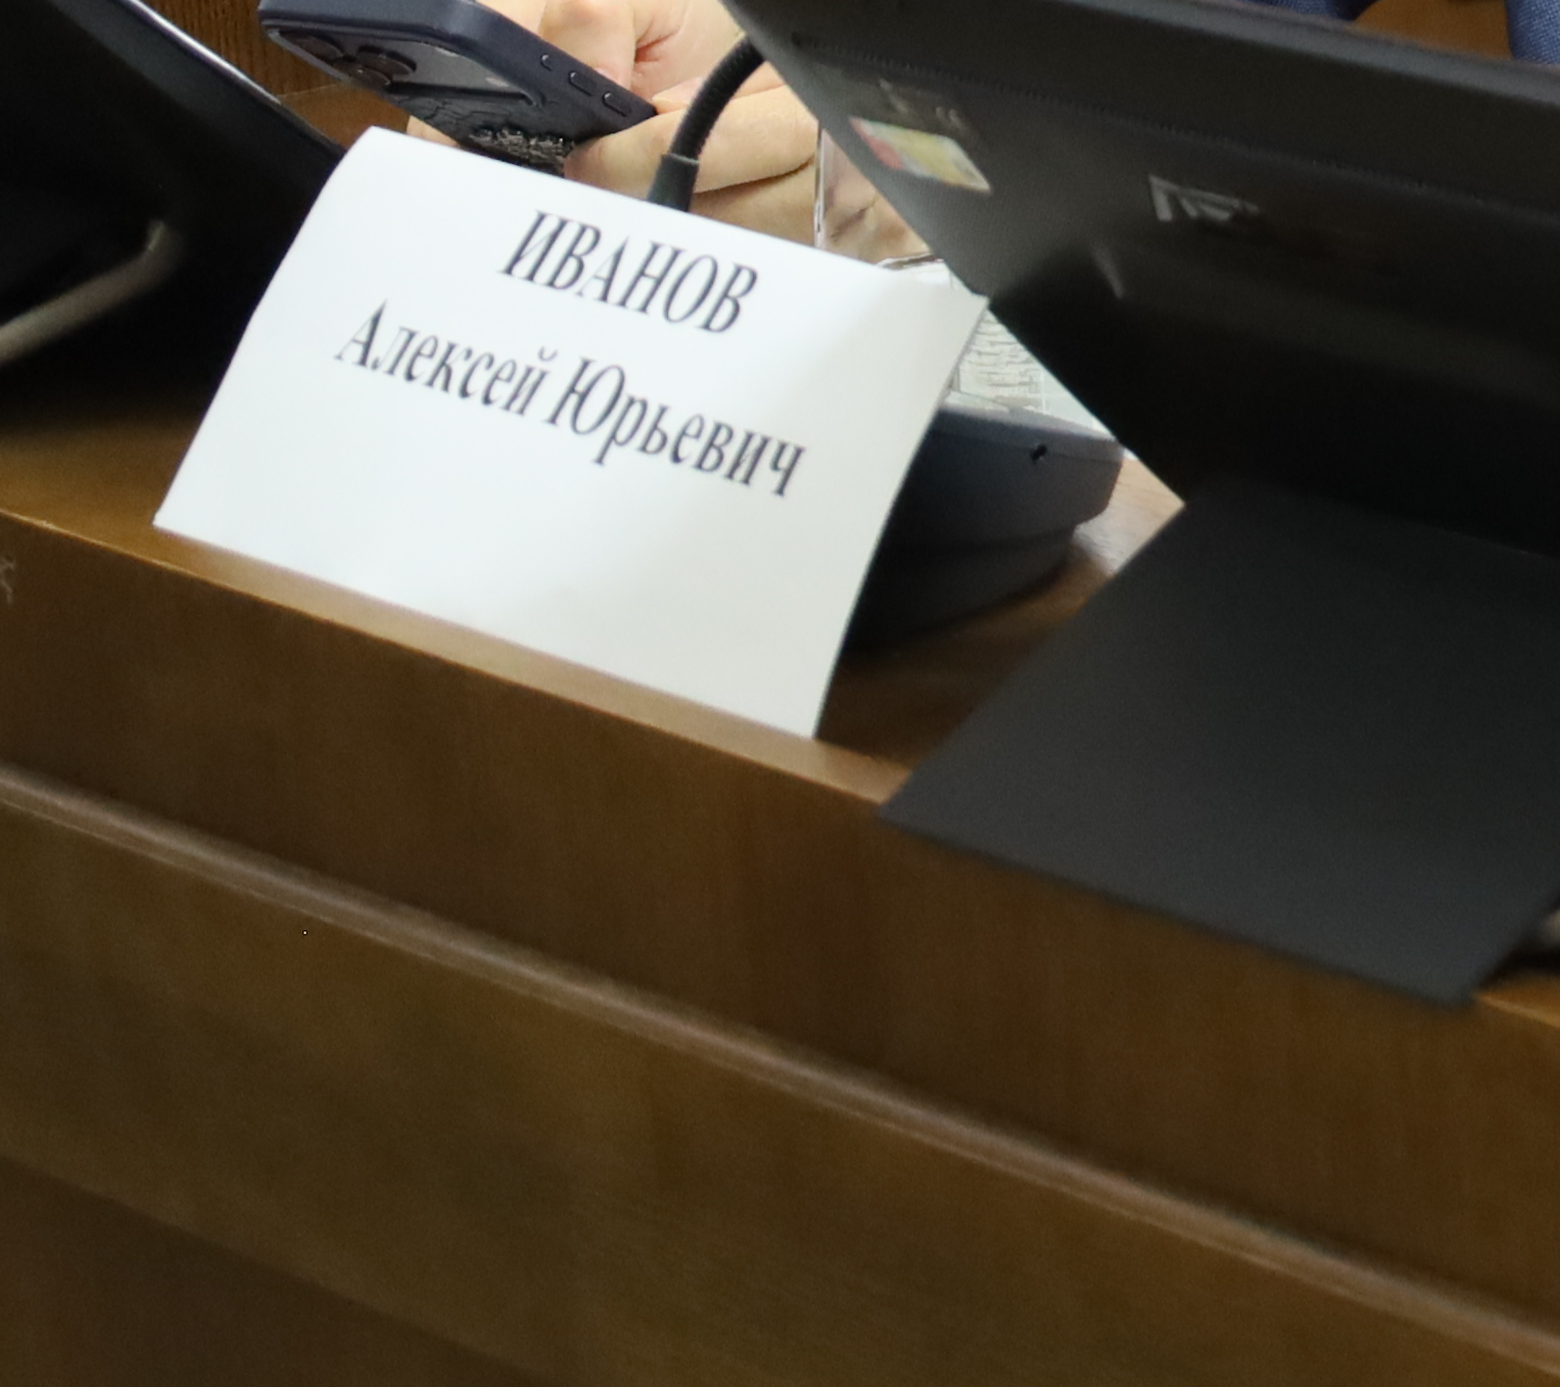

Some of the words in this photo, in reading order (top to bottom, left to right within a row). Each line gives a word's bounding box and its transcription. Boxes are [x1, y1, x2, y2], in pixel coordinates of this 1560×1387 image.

[500, 210, 759, 334] ИВАНОВ
[333, 299, 557, 419] Алексей
[546, 356, 808, 500] Юрьевич
